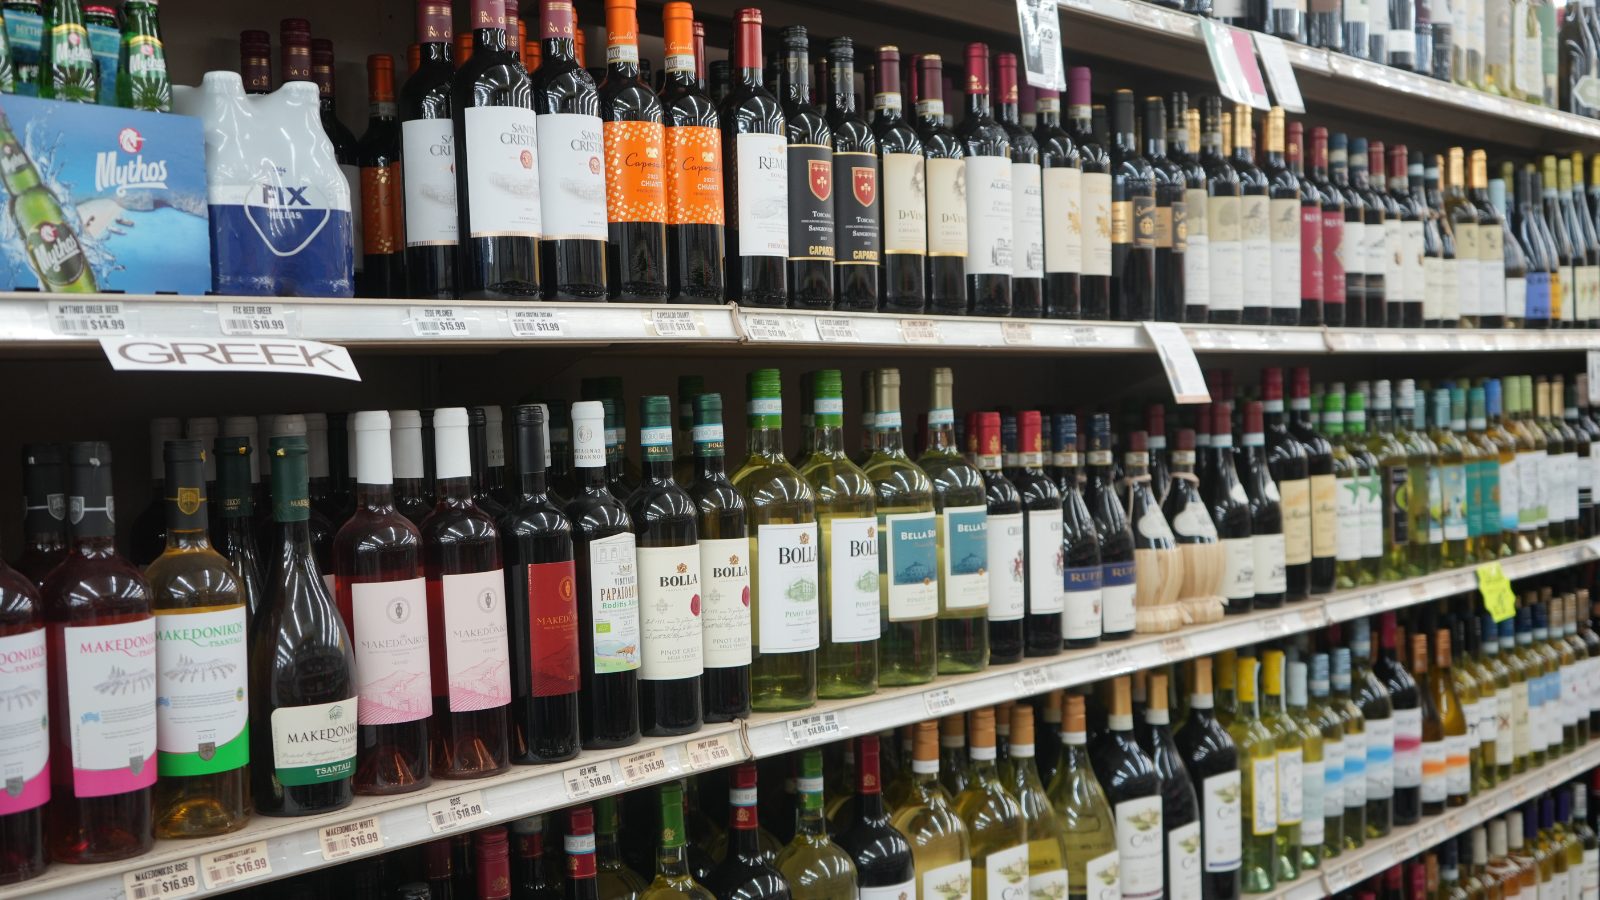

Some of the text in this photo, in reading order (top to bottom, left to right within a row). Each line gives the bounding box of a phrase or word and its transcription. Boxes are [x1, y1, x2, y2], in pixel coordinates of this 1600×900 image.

[15, 24, 42, 36] MYTH
[129, 53, 167, 75] Mythos
[500, 132, 537, 148] CRISTIN
[95, 151, 169, 197] Mythos
[262, 183, 311, 206] FIX
[269, 211, 301, 220] HELLAS
[34, 234, 82, 275] Mythos
[243, 306, 256, 315] BEER
[256, 306, 272, 315] GREEK
[90, 320, 125, 330] $14.99
[253, 320, 285, 330] $10.99
[439, 322, 466, 331] $15.99
[536, 322, 560, 331] $11.99
[118, 341, 346, 373] GREEK
[957, 524, 981, 532] BELLA
[901, 531, 927, 540] BELLA
[713, 566, 748, 578] BOLLA
[659, 574, 698, 588] BOLLA
[603, 601, 627, 609] Roditis
[209, 636, 242, 648] TSANTALI
[361, 634, 428, 649] MAKEDONIKOS
[711, 749, 730, 760] $9.99
[315, 762, 351, 775] TSANTALI
[643, 759, 665, 773] $14.99
[588, 775, 612, 788] $18.99
[456, 804, 482, 820] $18.99
[359, 818, 375, 831] WHITE
[350, 832, 379, 848] $16.99
[135, 861, 189, 882] MAKEDONIKOS ROSE
[236, 857, 267, 876] $16.99
[162, 875, 196, 893] $16.99
